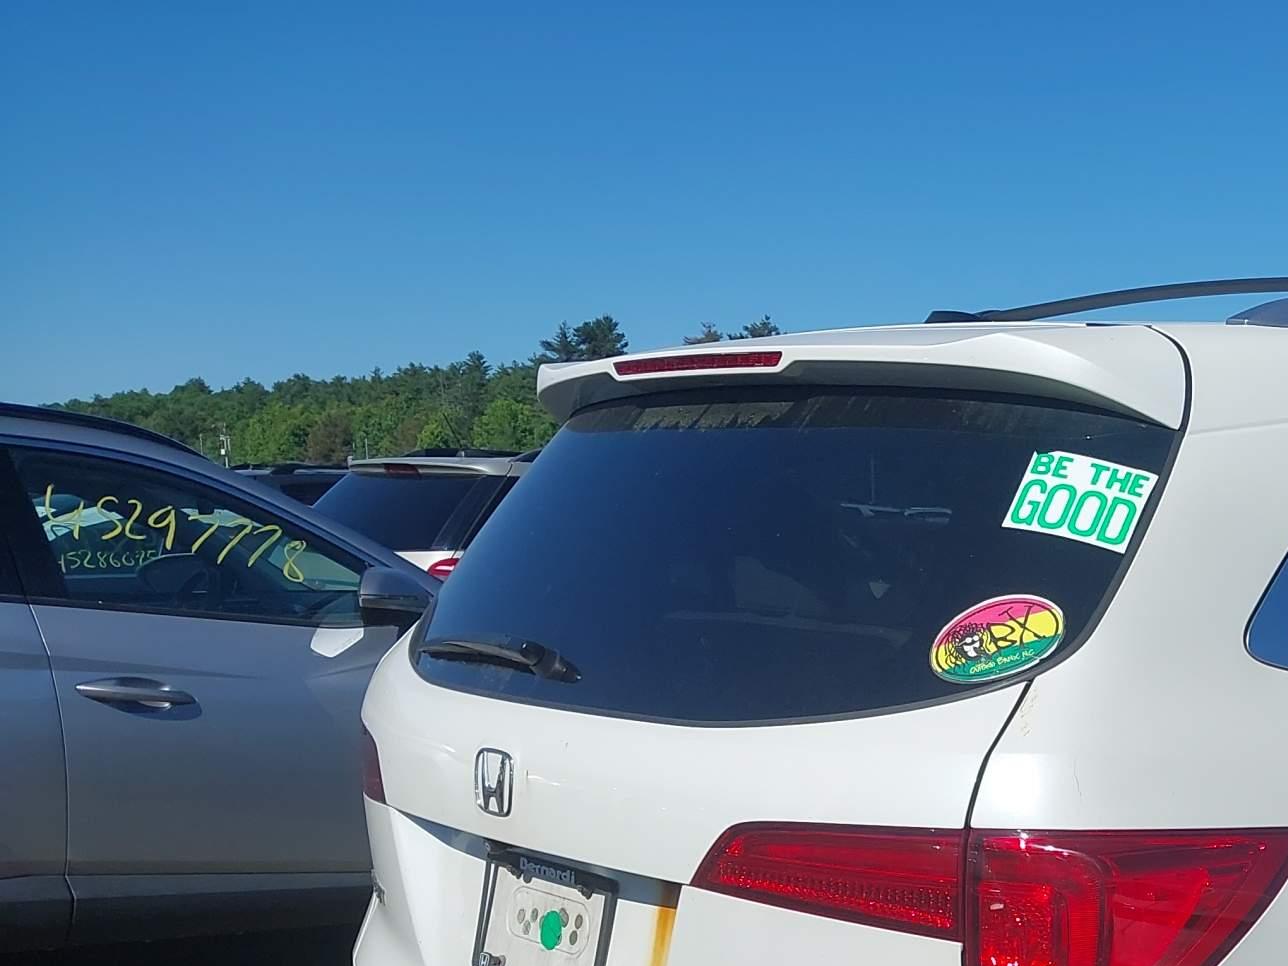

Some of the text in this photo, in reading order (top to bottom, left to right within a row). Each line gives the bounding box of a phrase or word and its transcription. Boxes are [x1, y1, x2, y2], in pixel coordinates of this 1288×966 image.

[1030, 453, 1150, 498] BE THE
[1010, 478, 1138, 546] GOOD
[520, 857, 575, 885] Bernardi
